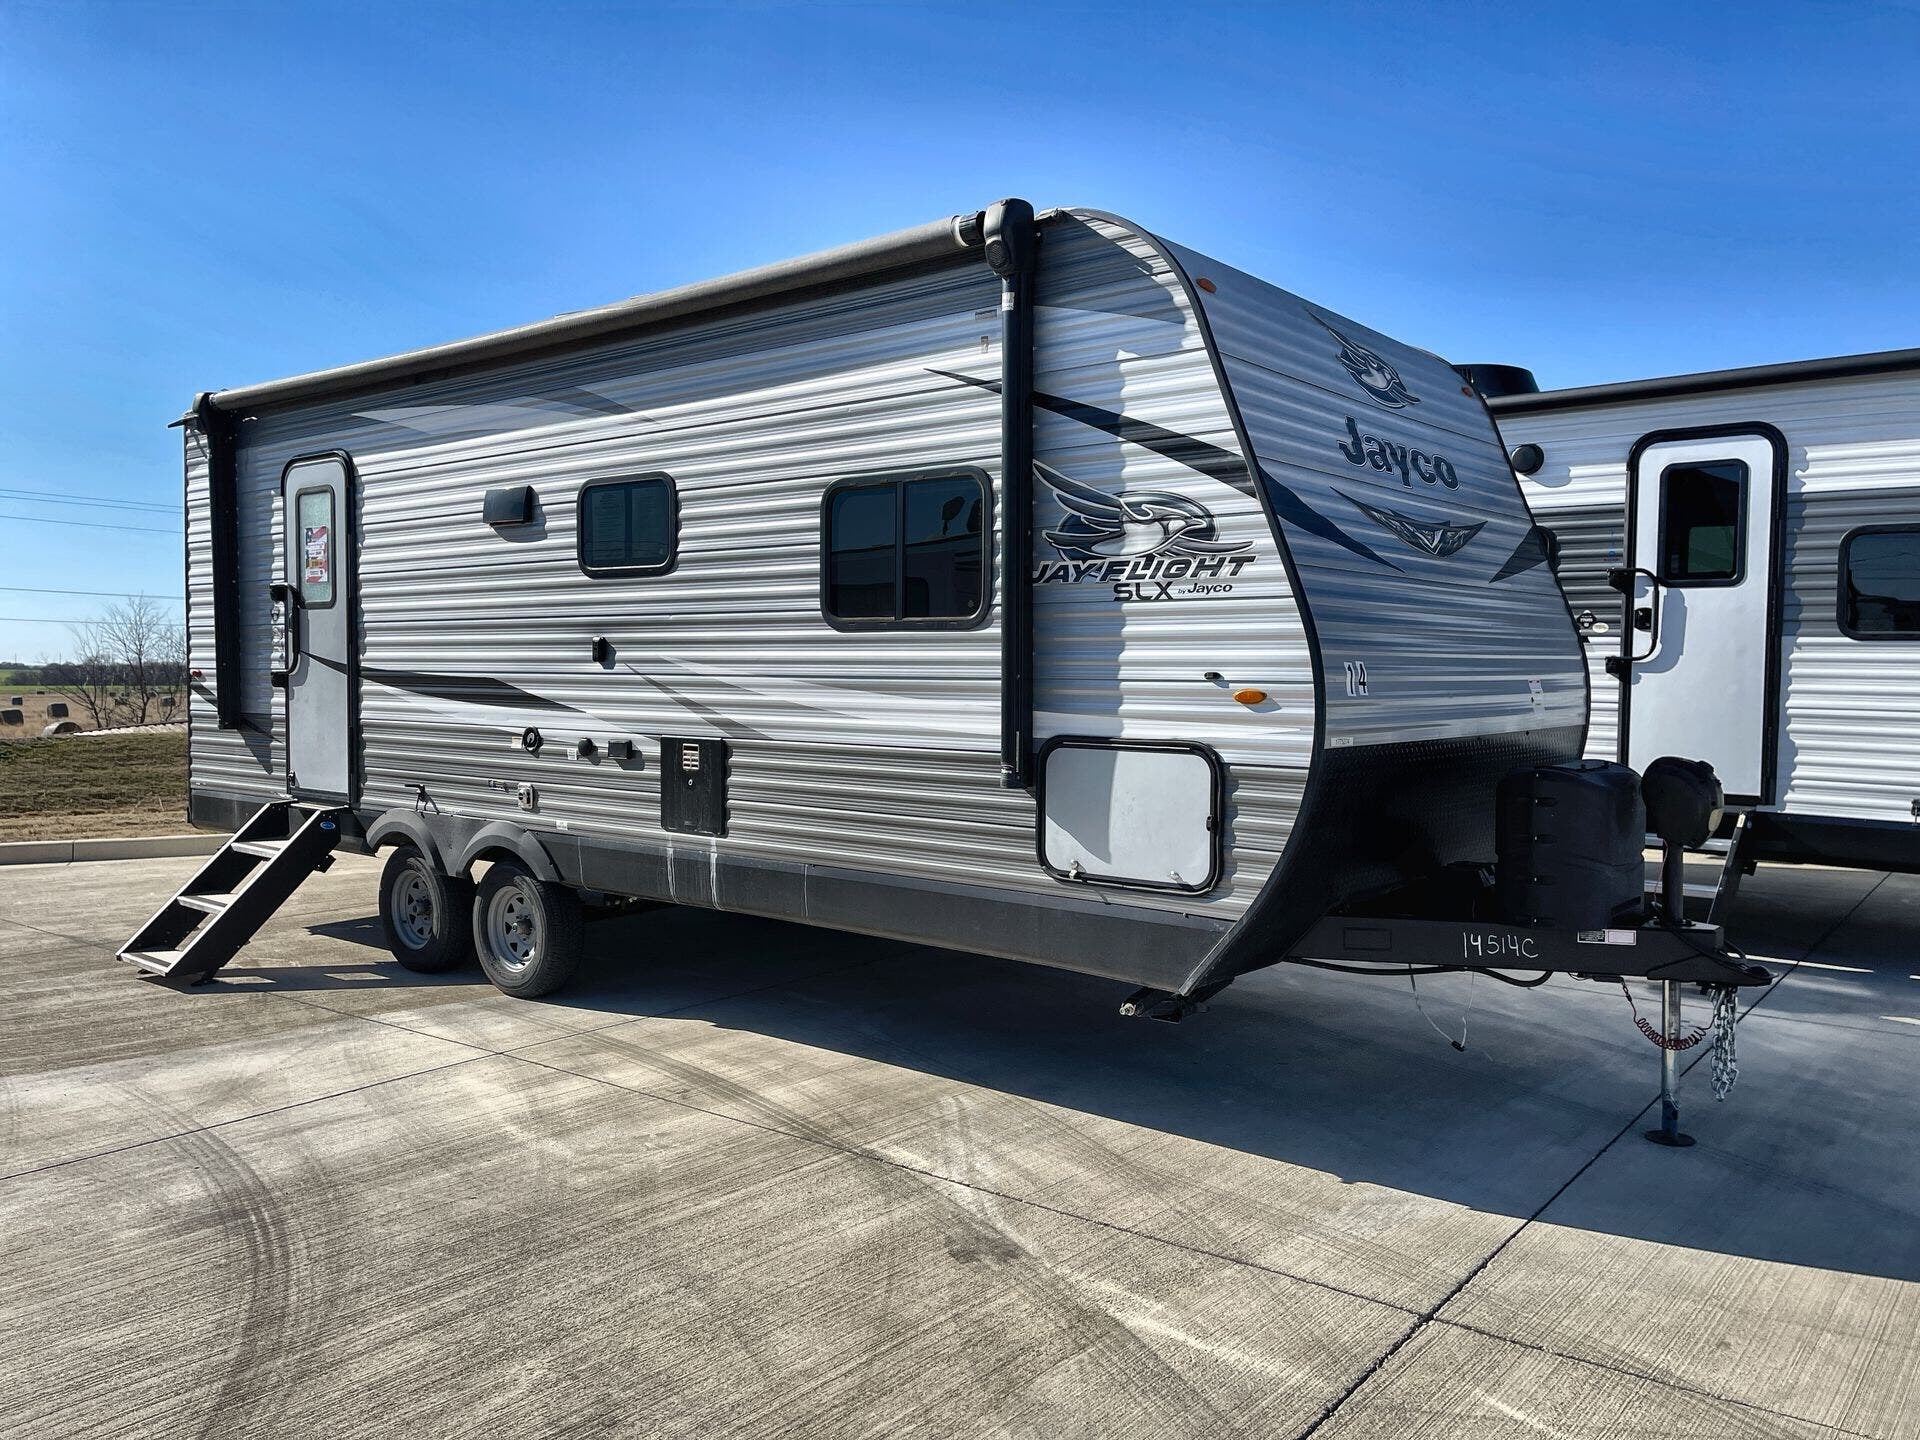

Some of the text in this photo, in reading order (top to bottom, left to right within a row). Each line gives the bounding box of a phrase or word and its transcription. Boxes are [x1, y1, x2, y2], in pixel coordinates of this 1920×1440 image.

[1337, 415, 1459, 490] Jayco
[1097, 555, 1257, 583] FLIGHT
[1113, 582, 1174, 601] SLX
[1187, 582, 1233, 595] Jayco
[1347, 663, 1367, 695] 14
[1463, 930, 1539, 959] 14514C
